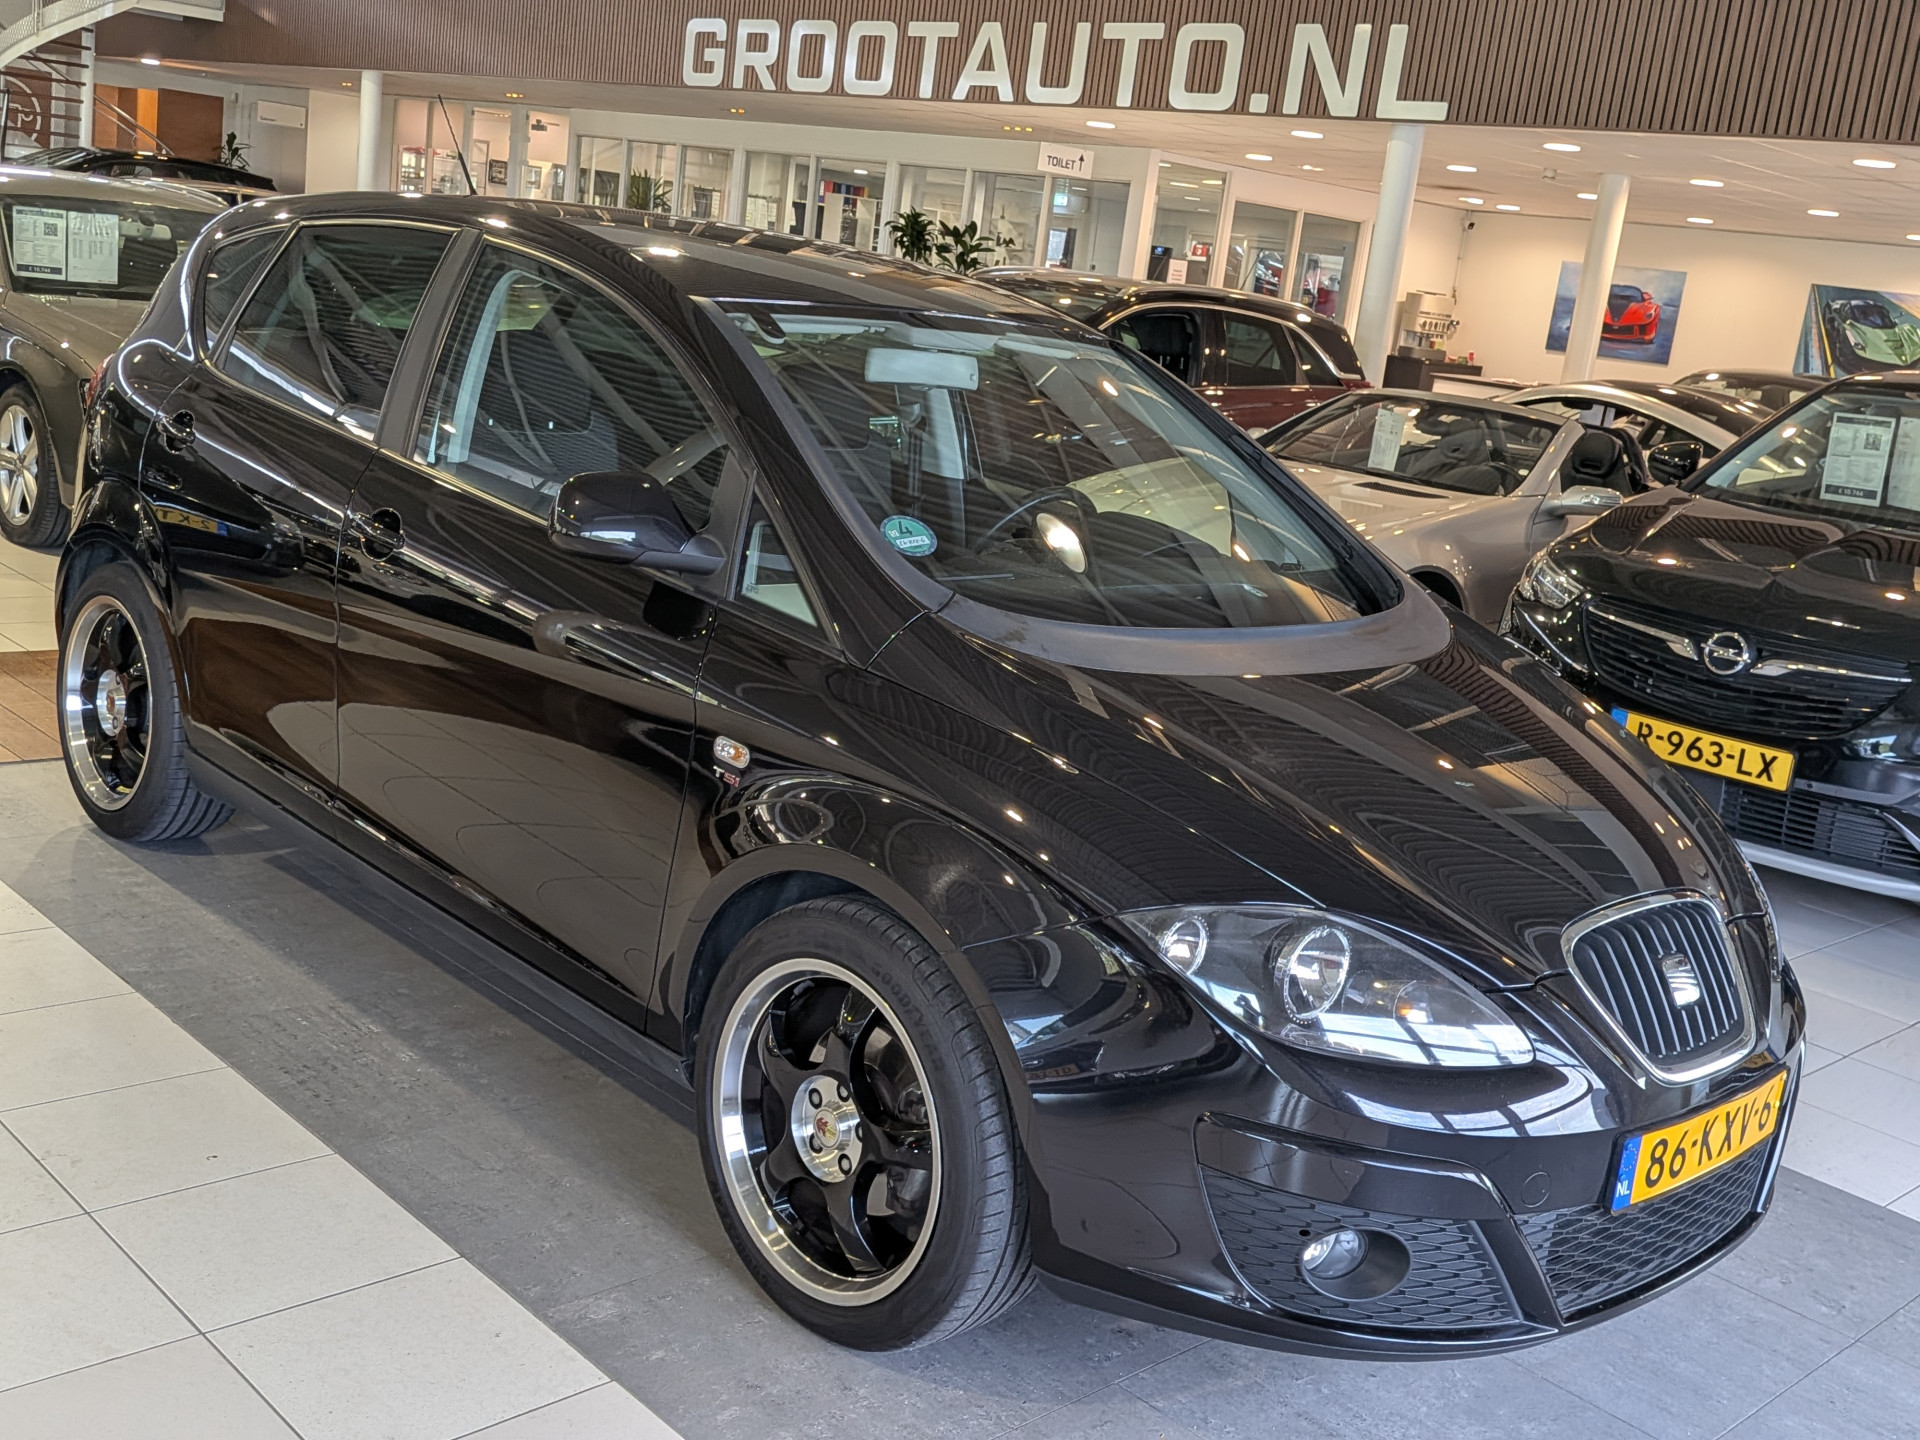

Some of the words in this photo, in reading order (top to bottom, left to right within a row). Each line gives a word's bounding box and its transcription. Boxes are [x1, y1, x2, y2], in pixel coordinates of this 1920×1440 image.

[682, 17, 1450, 122] GROOTAUTO.NL
[1047, 154, 1077, 171] TOILET
[712, 765, 741, 788] TSI
[1645, 1084, 1775, 1189] 86-KXV-6
[1615, 1179, 1631, 1198] NL
